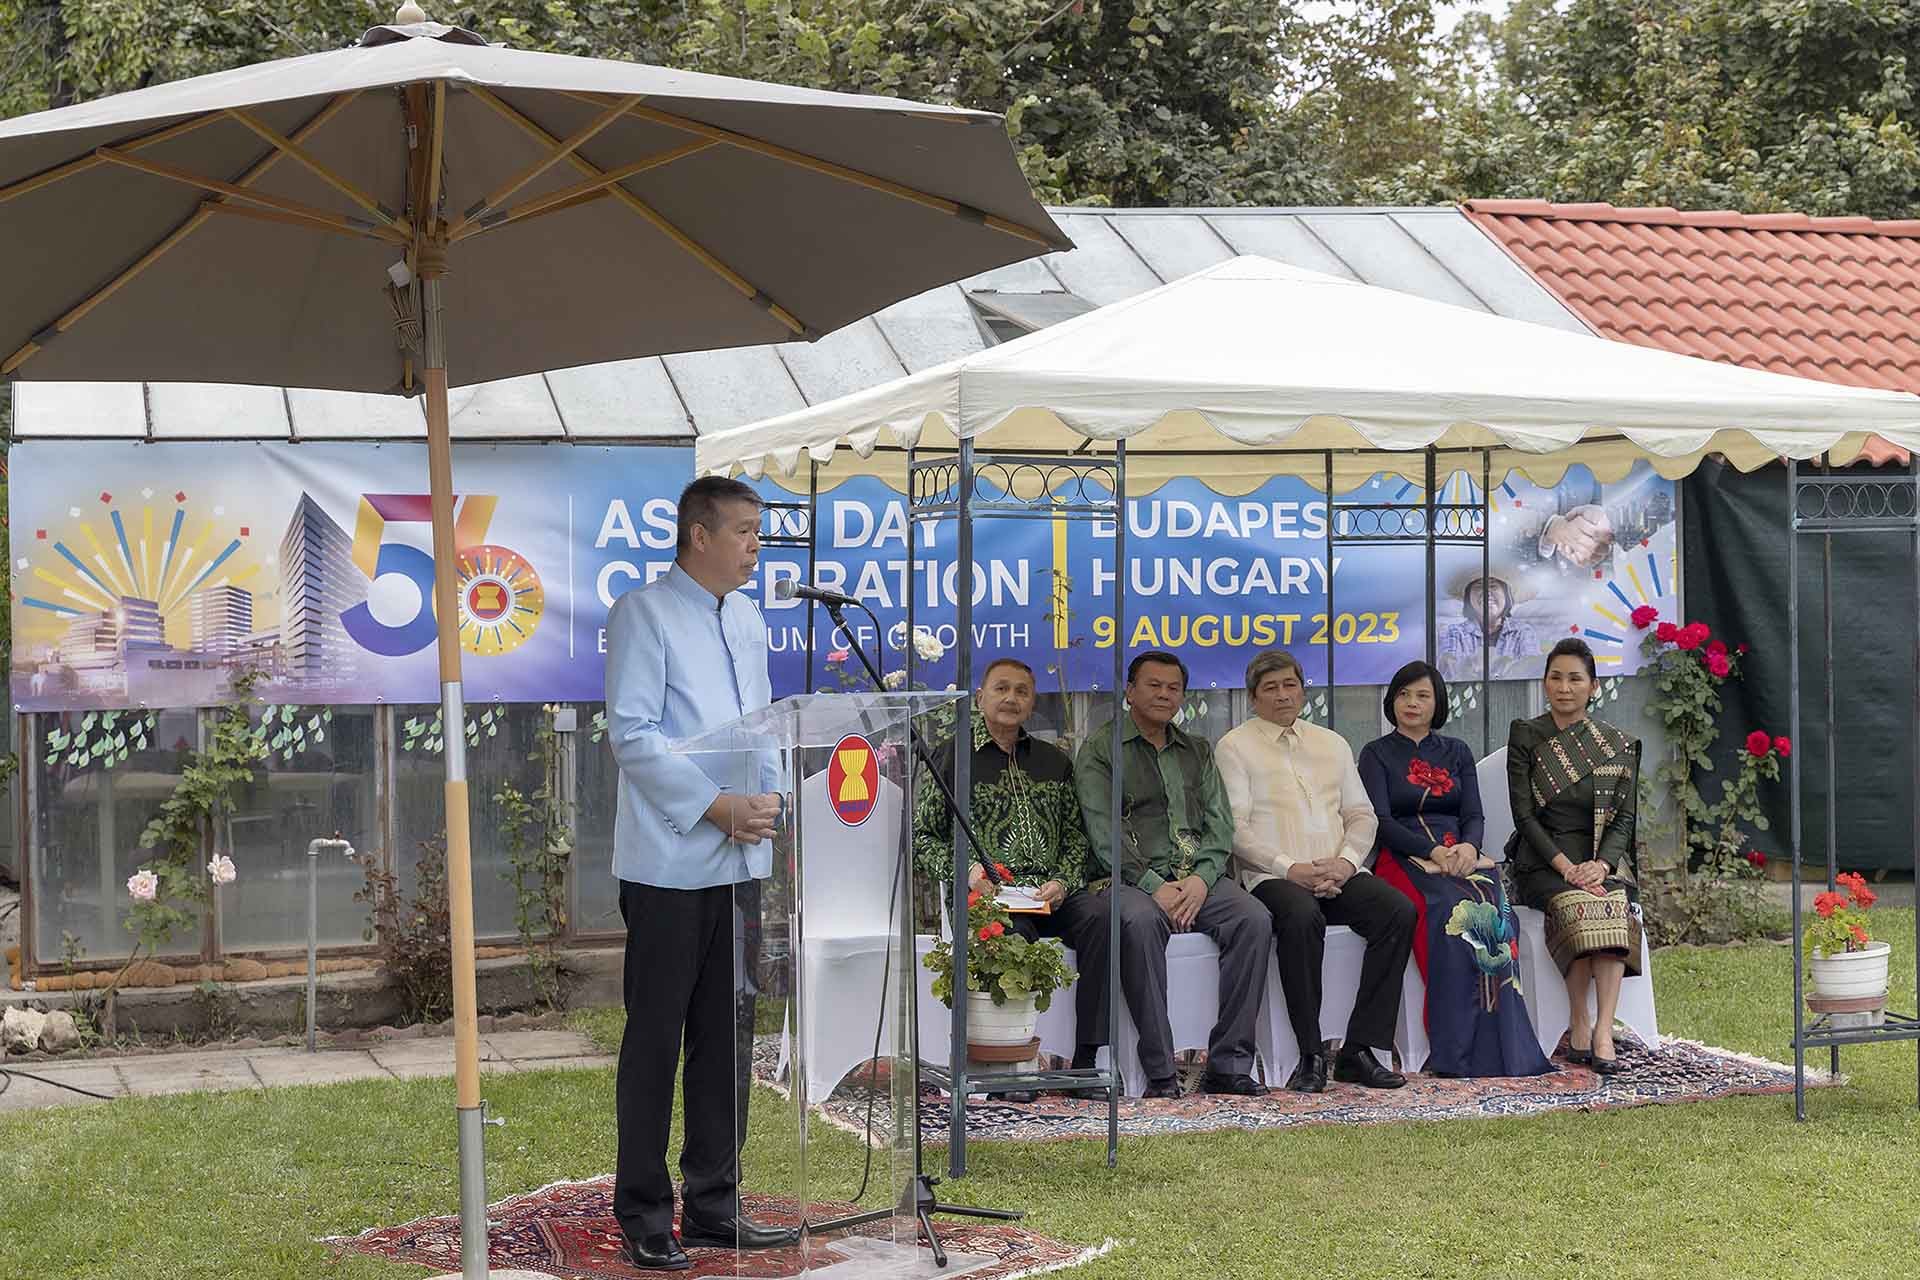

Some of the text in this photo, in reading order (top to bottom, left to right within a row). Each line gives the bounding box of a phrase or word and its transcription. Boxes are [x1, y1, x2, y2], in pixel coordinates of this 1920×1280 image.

[595, 499, 944, 549] ASN DAY
[1092, 500, 1359, 538] BUDAPEST
[596, 560, 1029, 610] CBRATION
[1092, 557, 1342, 596] HUNGARY
[831, 626, 873, 651] OF
[1092, 612, 1400, 648] 9 AUGUST 2023
